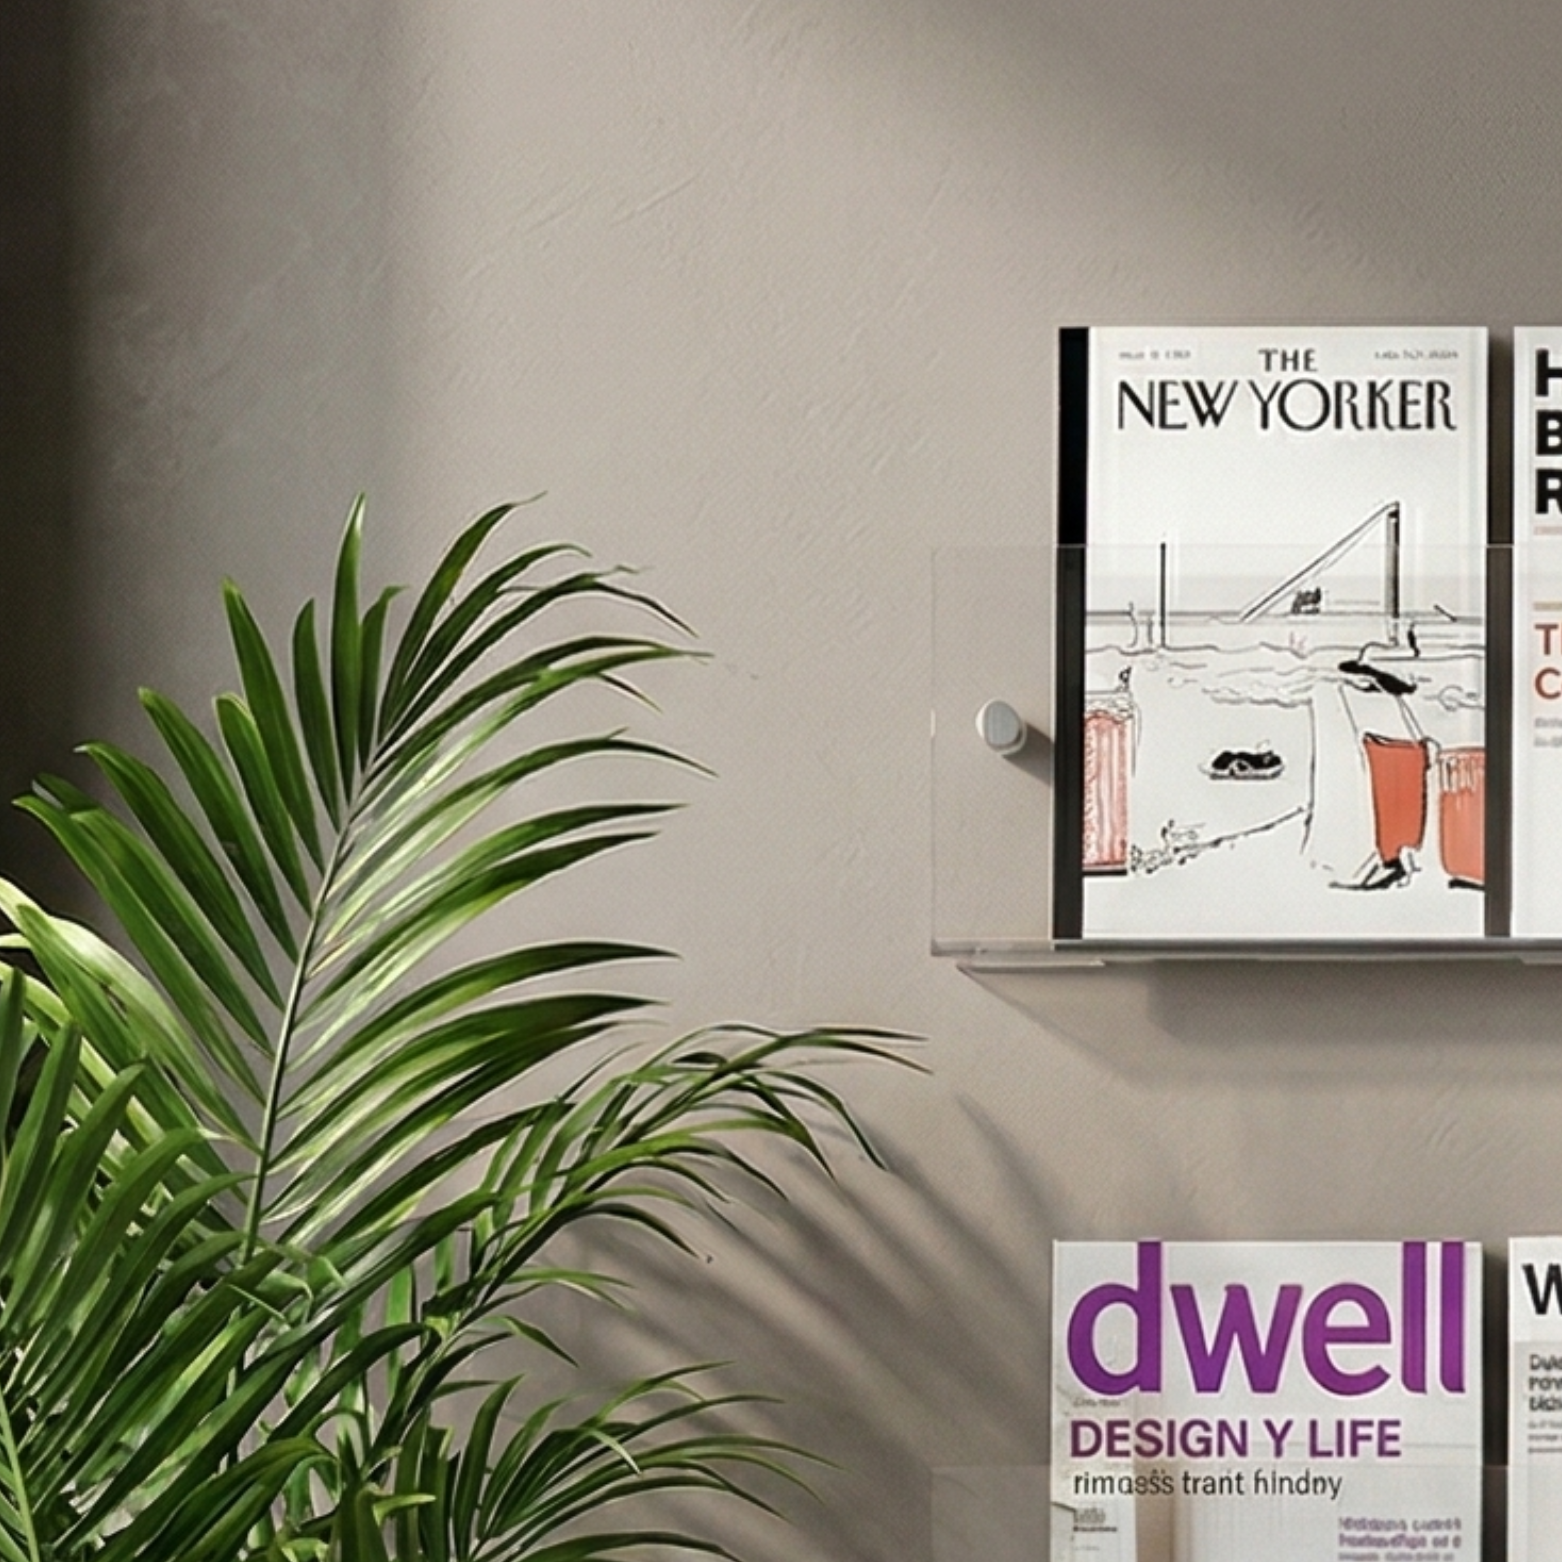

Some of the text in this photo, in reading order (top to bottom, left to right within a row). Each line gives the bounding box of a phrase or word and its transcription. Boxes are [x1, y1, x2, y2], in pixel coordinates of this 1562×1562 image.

[1258, 349, 1317, 371] THE
[1118, 379, 1457, 431] NEW YORKER
[1067, 1240, 1467, 1396] dwell
[1070, 1420, 1402, 1458] DESIGN Y LIFE
